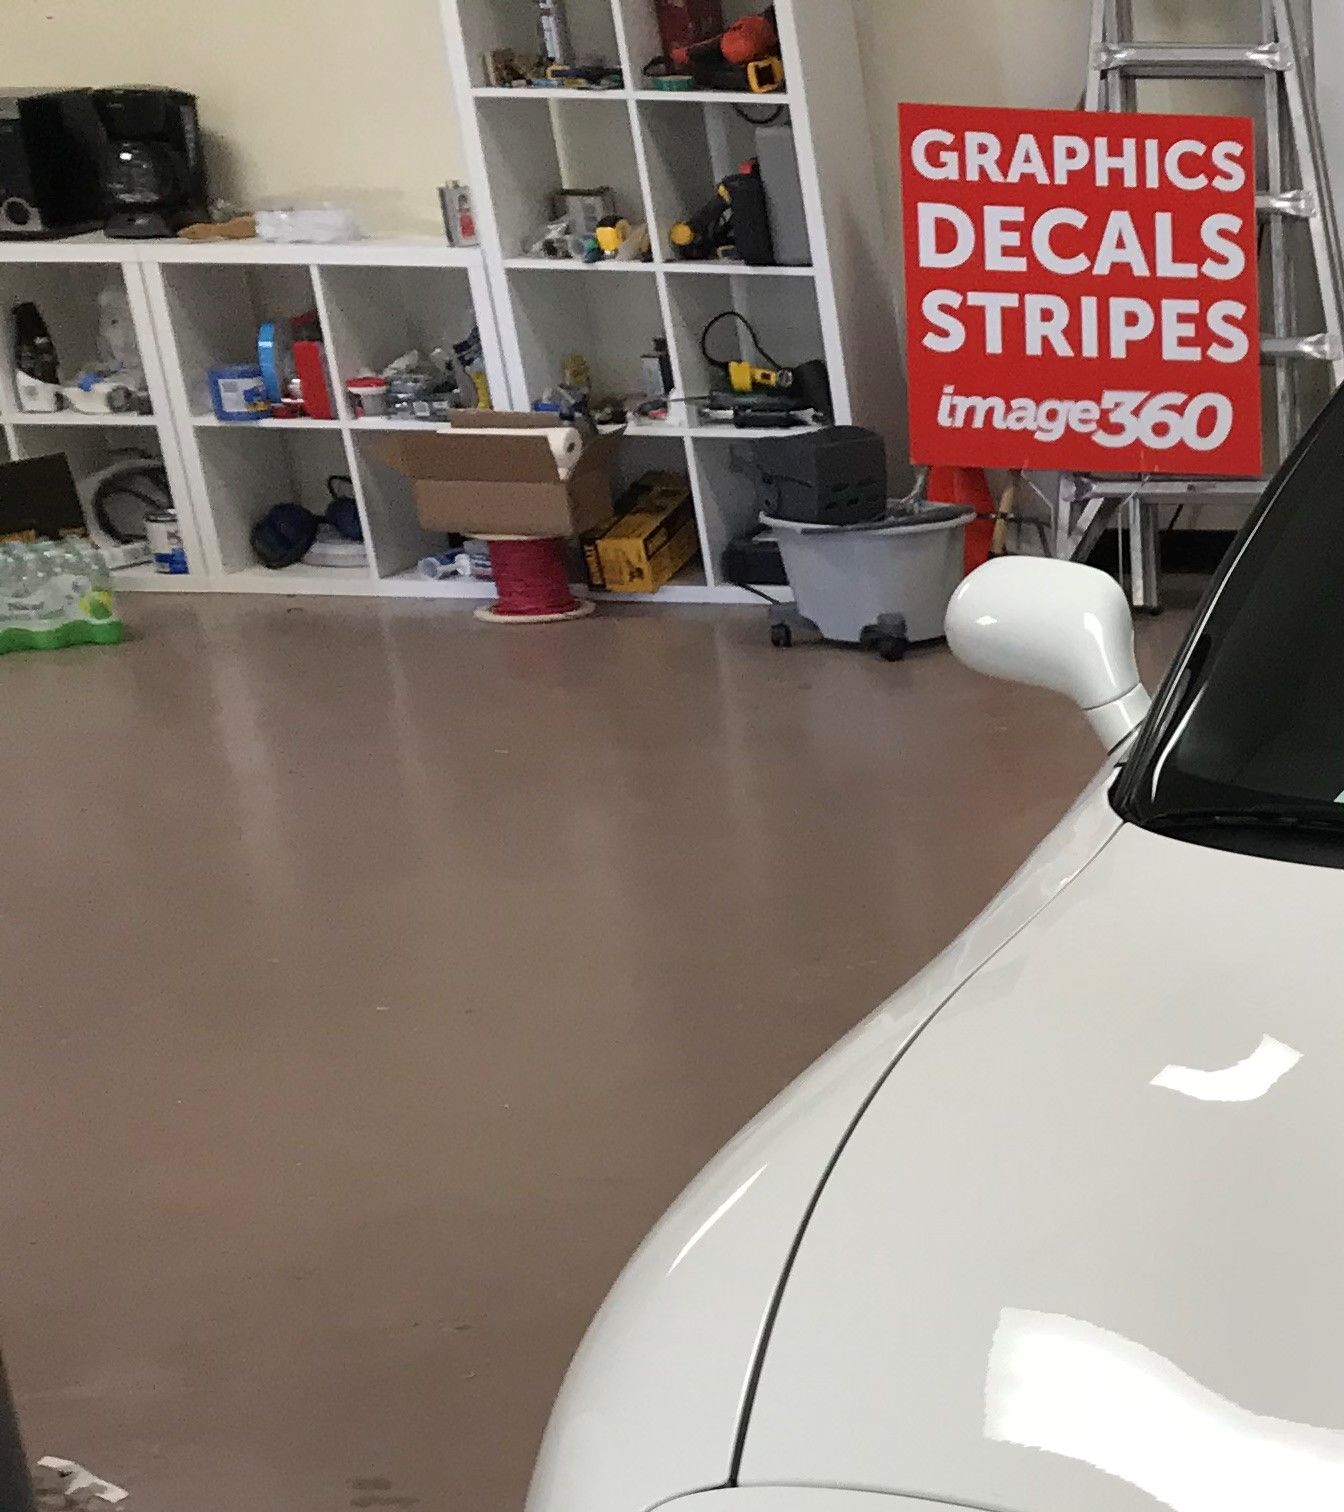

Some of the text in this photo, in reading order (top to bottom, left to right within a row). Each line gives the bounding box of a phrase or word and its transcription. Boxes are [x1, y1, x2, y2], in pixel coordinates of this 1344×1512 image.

[911, 129, 1246, 192] GRAPHICS
[917, 202, 1245, 280] DECALS
[921, 289, 1249, 364] STRIPES
[937, 384, 1233, 452] image360
